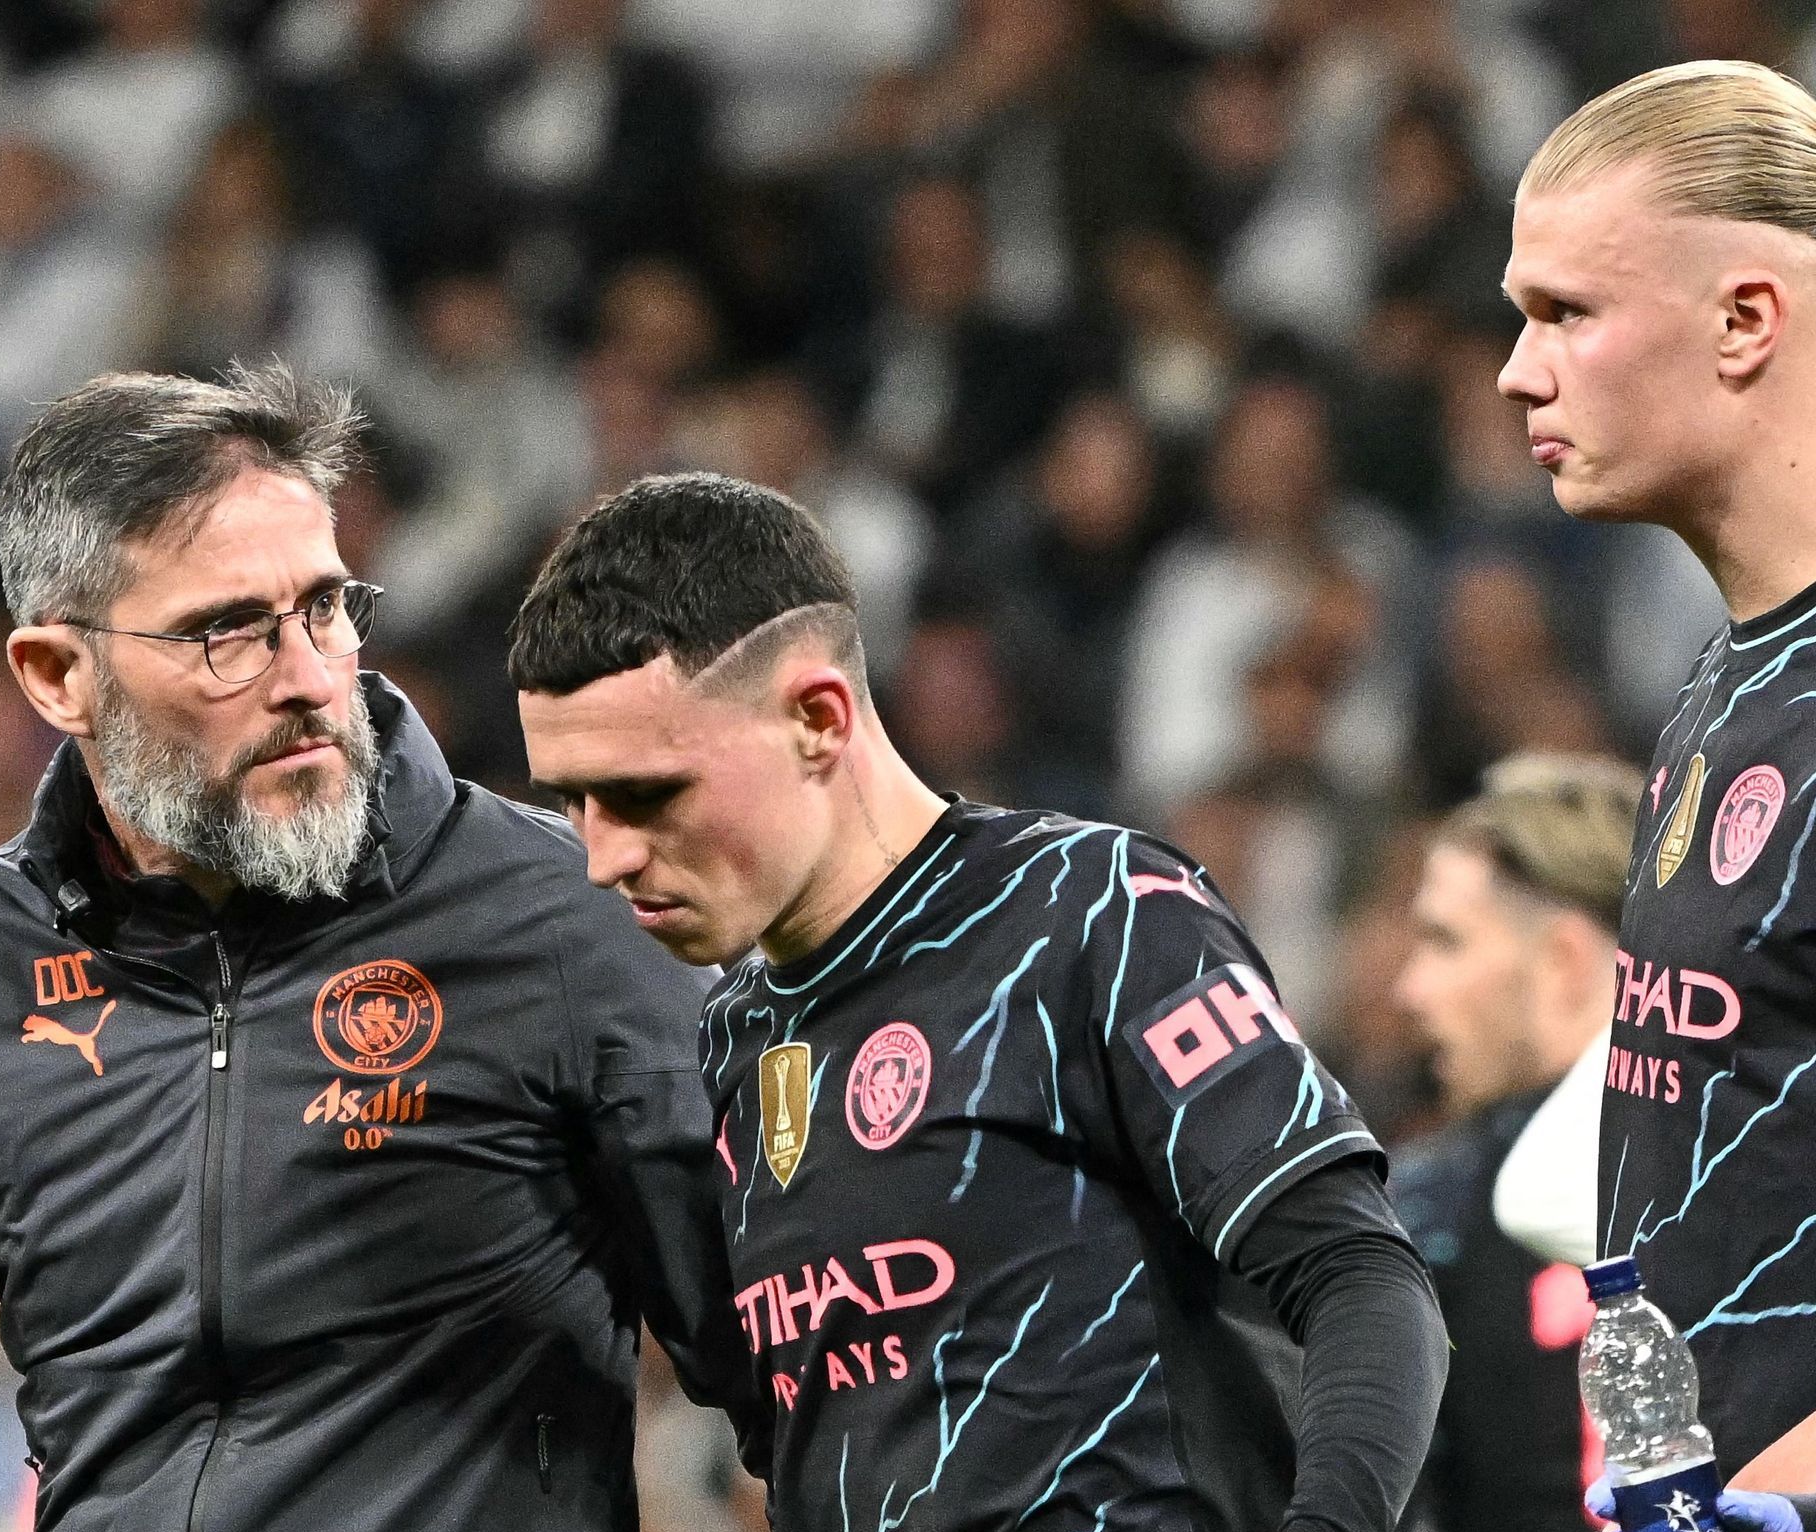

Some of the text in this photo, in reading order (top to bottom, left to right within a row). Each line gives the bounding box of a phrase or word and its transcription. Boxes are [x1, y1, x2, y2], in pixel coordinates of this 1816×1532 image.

[33, 950, 105, 1006] DOC
[331, 967, 431, 1009] MANCHESTER
[1614, 948, 1742, 1041] TIHAD
[354, 1055, 391, 1068] CITY
[858, 1031, 924, 1075] MANCHESTER
[1607, 1045, 1681, 1104] RWAYS
[303, 1077, 428, 1125] Asahi
[773, 1130, 796, 1153] FIFA
[868, 1124, 892, 1140] CITY
[734, 1238, 956, 1355] TIHAD
[772, 1334, 909, 1412] RAYS
